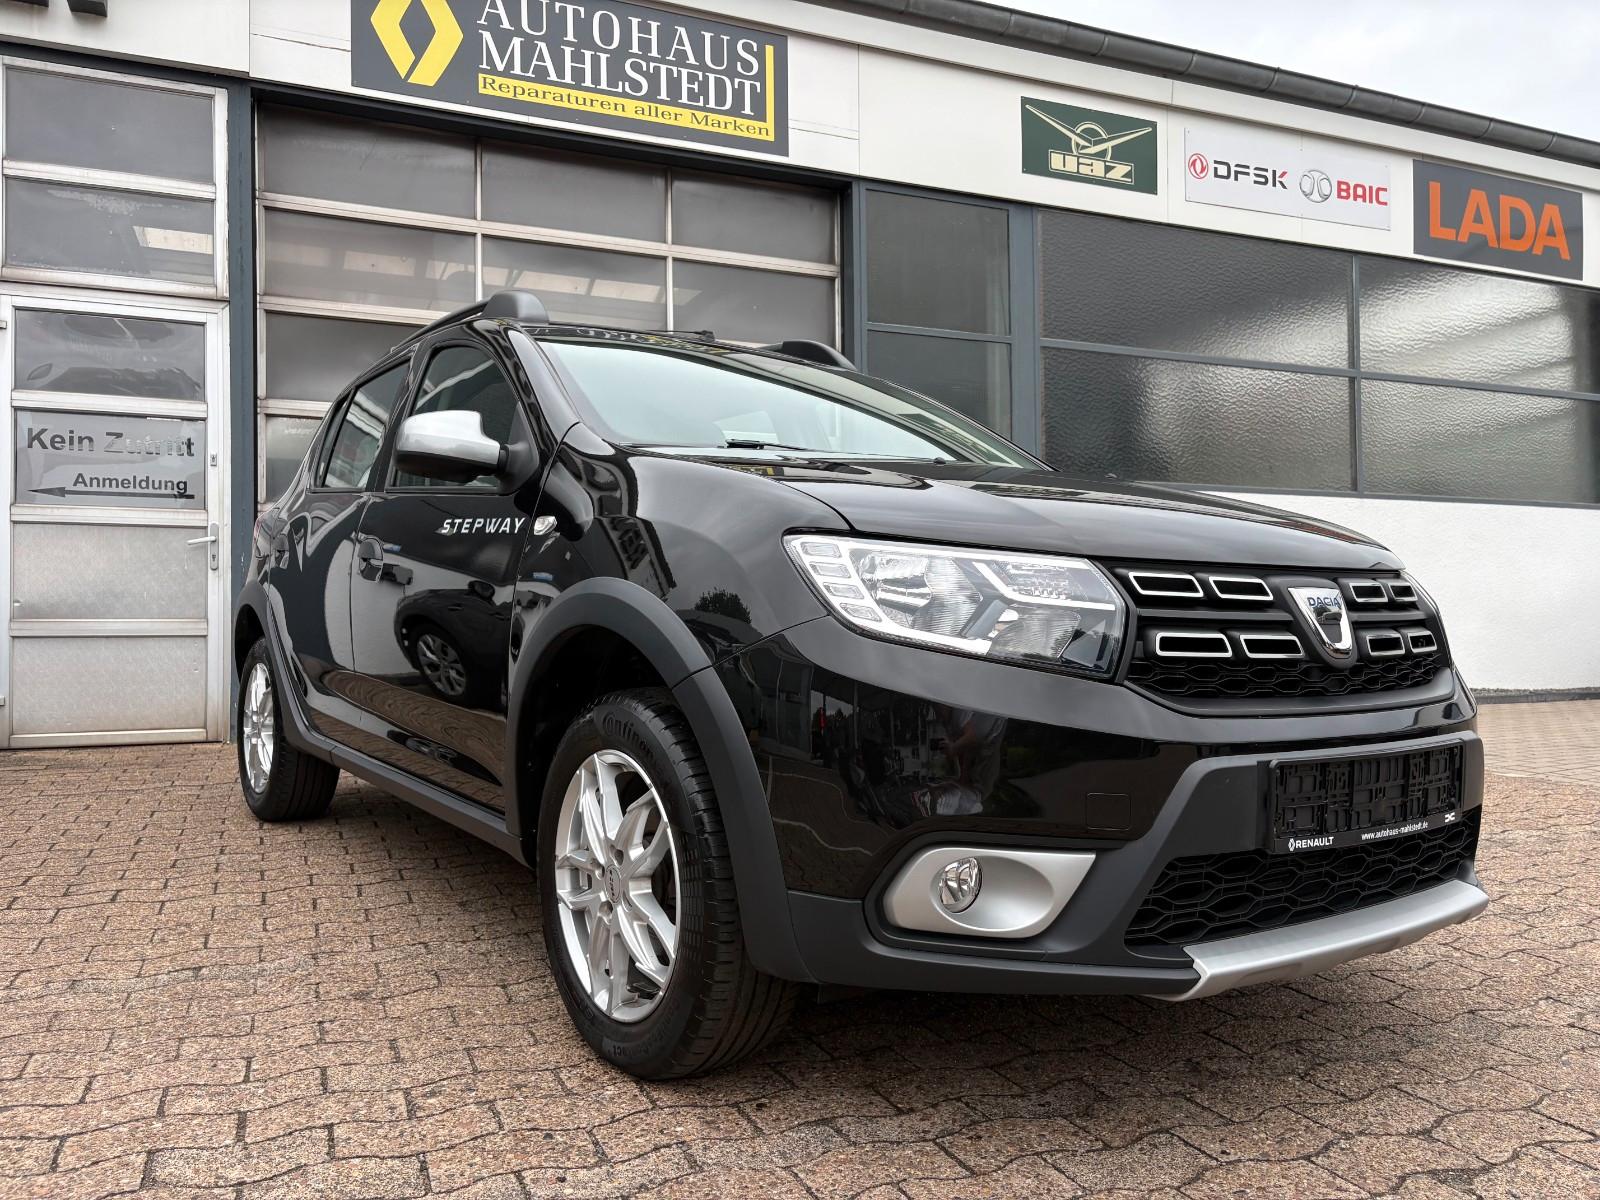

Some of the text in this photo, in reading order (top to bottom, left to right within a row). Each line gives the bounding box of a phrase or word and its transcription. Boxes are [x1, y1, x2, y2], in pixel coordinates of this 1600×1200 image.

[477, 0, 760, 76] AUTOHAUS
[478, 29, 761, 117] MAHLSTEDT
[481, 76, 770, 137] Reparaturen aller Marken
[1213, 159, 1288, 190] DFSK
[1336, 180, 1389, 206] BAIC
[1429, 181, 1571, 260] LADA
[27, 427, 94, 452] Kein
[72, 472, 188, 495] Anmeldung
[441, 517, 525, 534] STEPWAY
[1307, 596, 1342, 610] DACIA
[1295, 836, 1334, 849] RENAULT
